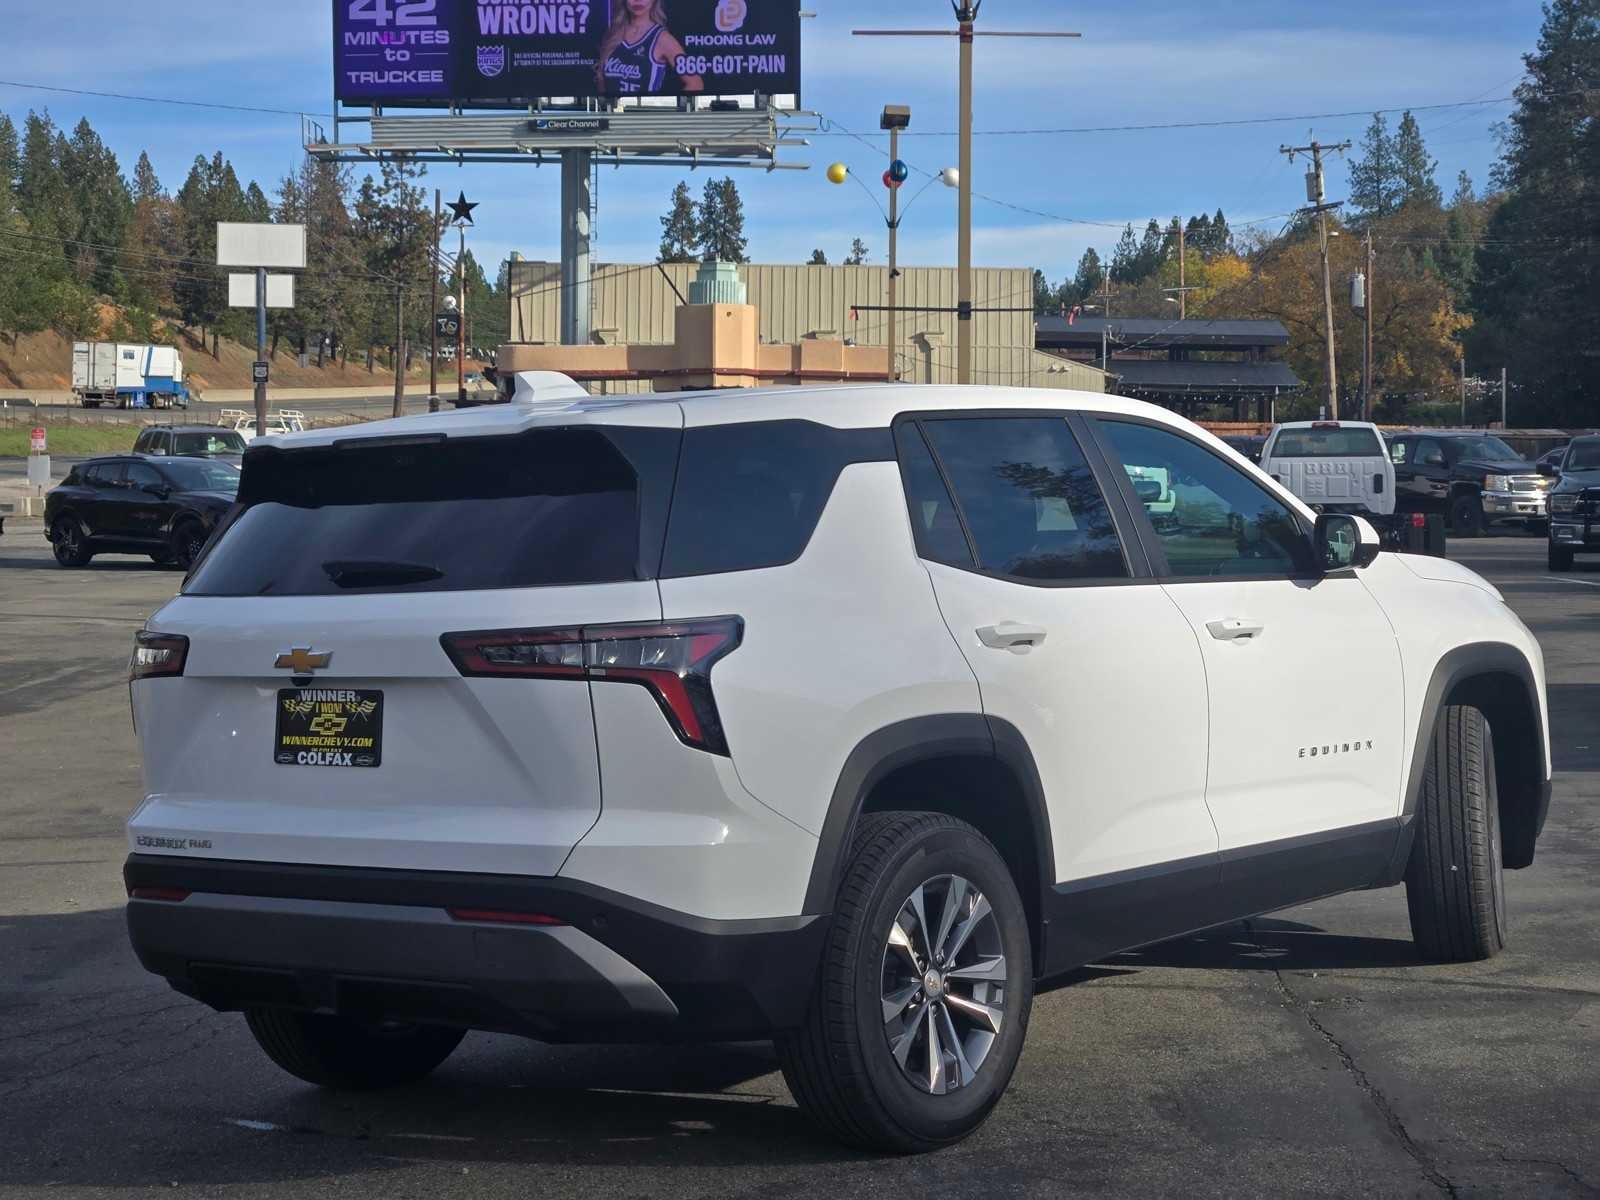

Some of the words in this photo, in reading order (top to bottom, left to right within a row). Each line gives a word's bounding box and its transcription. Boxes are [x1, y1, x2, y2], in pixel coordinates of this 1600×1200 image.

[348, 0, 438, 26] 42
[477, 4, 590, 35] WRONG?
[344, 30, 450, 46] MINUTES
[685, 34, 743, 46] PHOONG
[745, 34, 776, 46] LAW
[384, 47, 411, 62] to
[675, 54, 786, 75] 866-GOT-PAIN
[346, 70, 444, 84] TRUCKEE
[548, 120, 567, 129] Clear
[568, 119, 599, 128] Channel
[300, 689, 356, 702] WINNER
[282, 735, 374, 748] WINNERCHEVY.COM
[1298, 740, 1373, 758] EQUINOX
[297, 751, 353, 766] COLFAX
